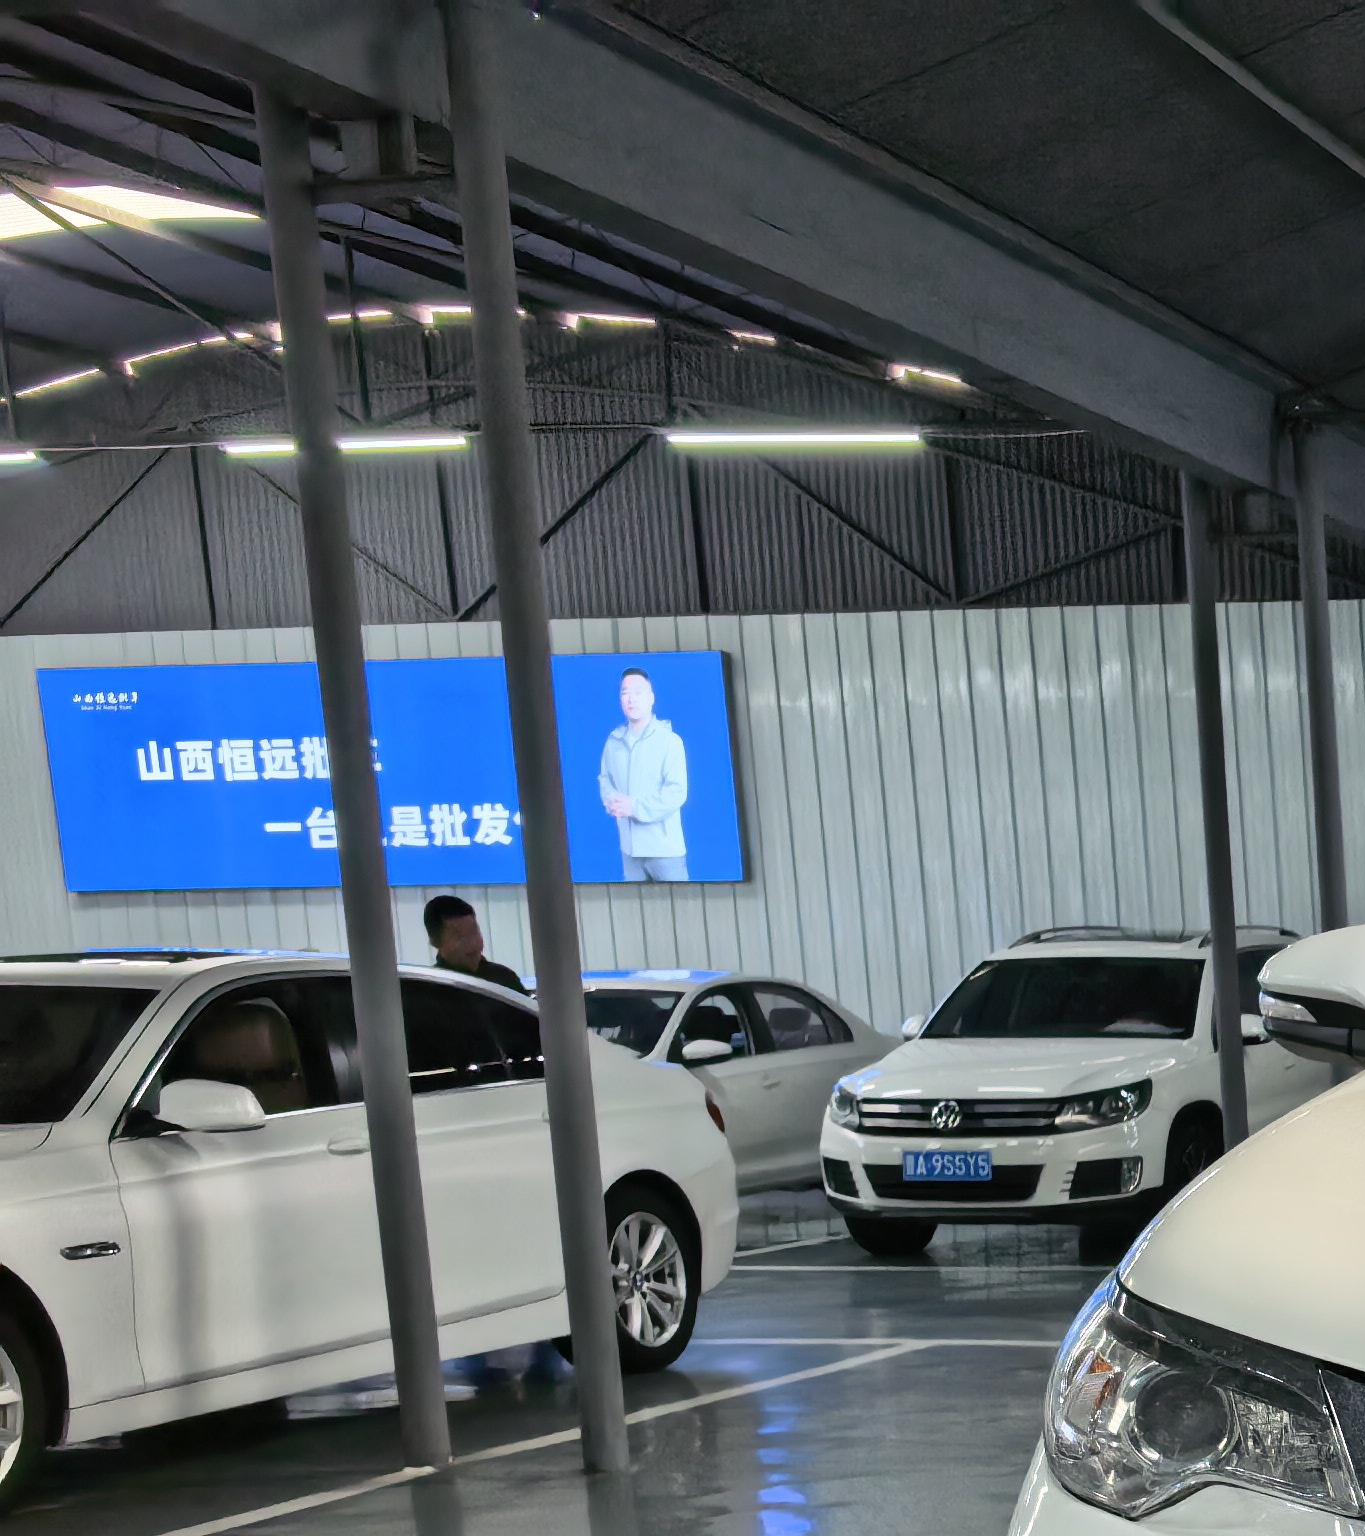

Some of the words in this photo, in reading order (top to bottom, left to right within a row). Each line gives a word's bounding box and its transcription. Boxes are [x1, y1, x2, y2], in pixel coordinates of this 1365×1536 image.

[137, 736, 382, 782] 山西恒远批
[264, 803, 521, 849] 一台是批发
